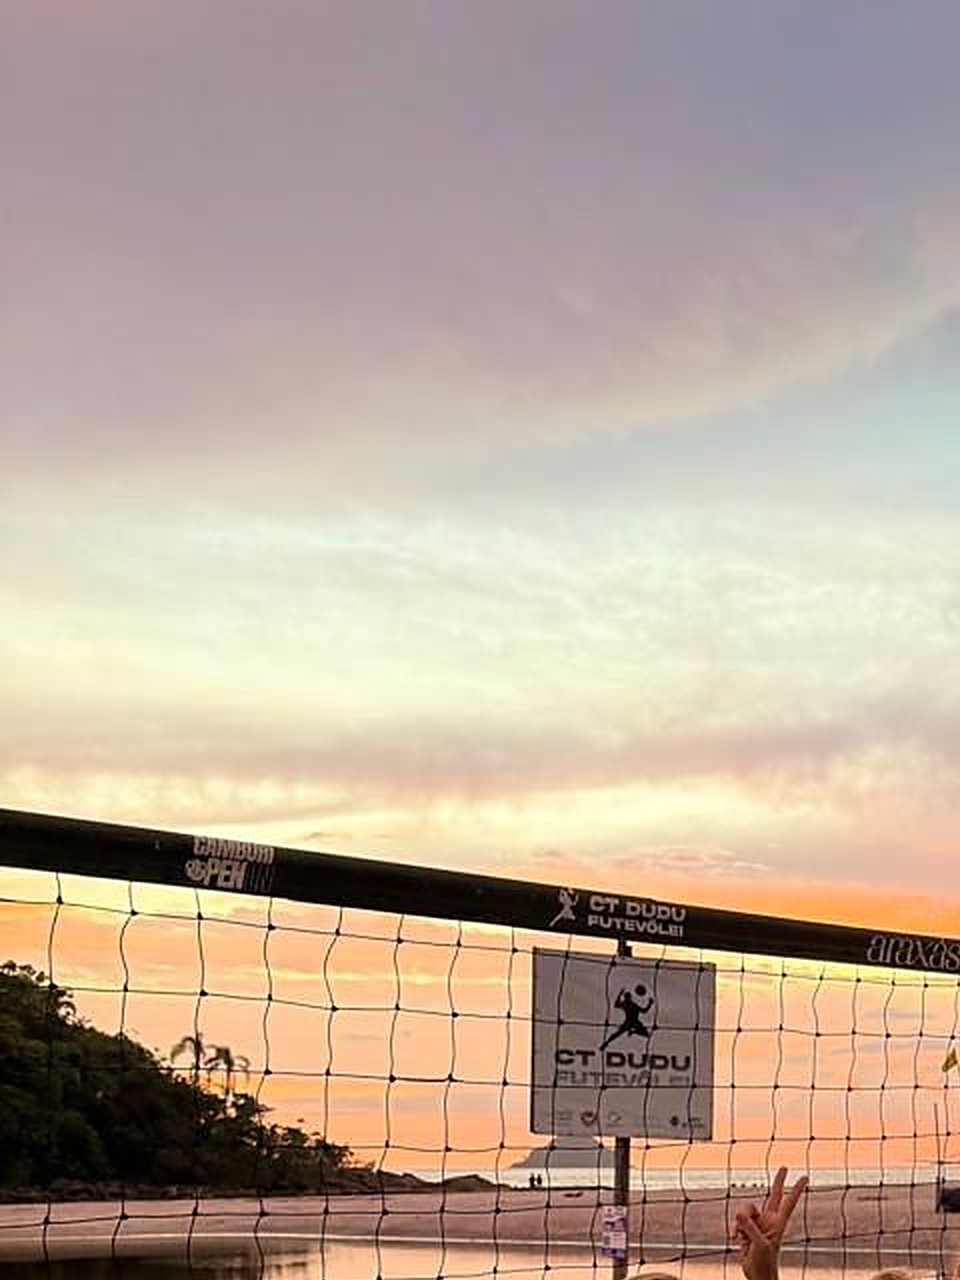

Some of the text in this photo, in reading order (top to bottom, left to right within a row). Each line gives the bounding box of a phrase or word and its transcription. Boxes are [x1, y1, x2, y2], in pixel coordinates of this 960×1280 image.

[185, 857, 248, 890] OPEN
[589, 894, 686, 922] CT DUDU
[556, 1049, 691, 1072] CT DUDU
